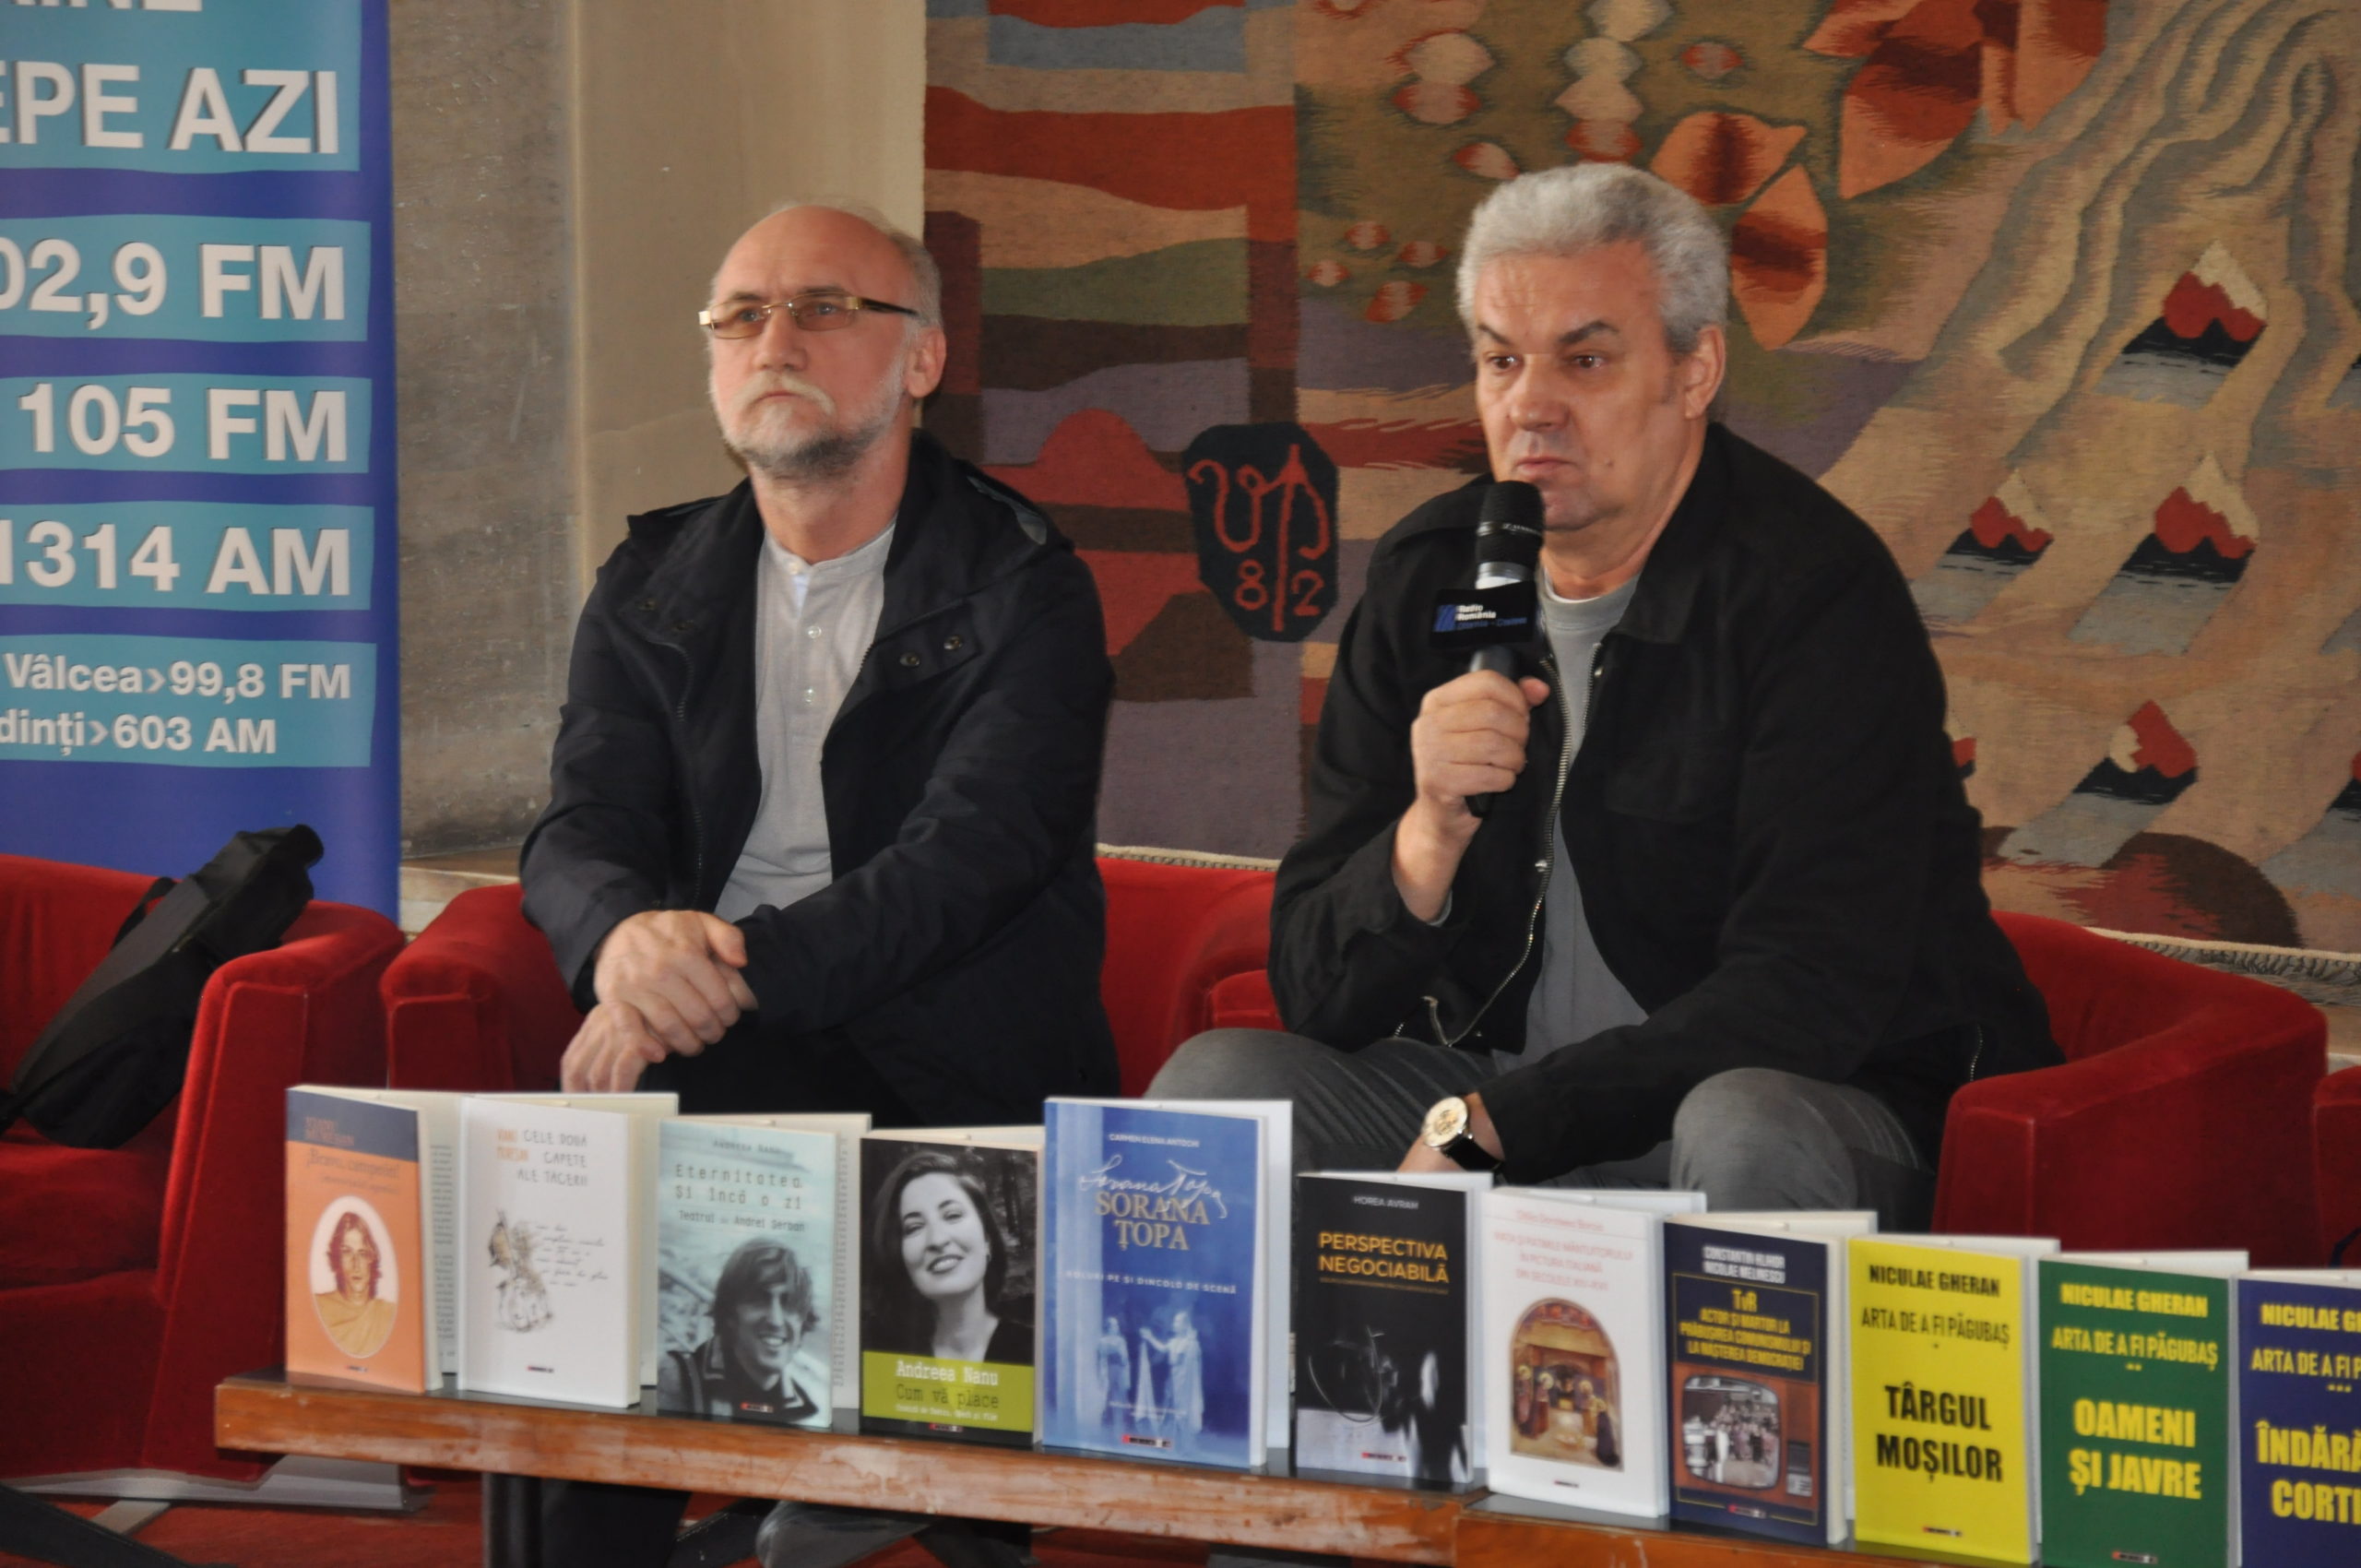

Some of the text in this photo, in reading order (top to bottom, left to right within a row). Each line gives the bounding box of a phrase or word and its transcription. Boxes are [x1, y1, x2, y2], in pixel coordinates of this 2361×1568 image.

[0, 59, 339, 154] PE AZI
[200, 244, 345, 320] FM
[18, 383, 347, 461] 105 FM
[0, 519, 350, 596] 1314 AM
[280, 663, 350, 699] FM
[204, 718, 277, 754] AM
[523, 1129, 553, 1146] CELE
[517, 1168, 539, 1183] ALE
[544, 1150, 587, 1169] CAPETE
[761, 1194, 769, 1207] o
[1095, 1191, 1211, 1226] SORANA
[1353, 1195, 1419, 1210] HOREA AVRAM
[1318, 1231, 1449, 1262] PERSPECTIVA
[1318, 1254, 1450, 1284] NEGOCIABILĂ
[1869, 1265, 2000, 1298] NICULAE GHERAN
[2060, 1282, 2208, 1318] NICULAE GHERAN
[2260, 1302, 2340, 1331] NICULAE
[1861, 1306, 2011, 1350] ARTA DE A FI PĂGUBAȘ
[2051, 1326, 2219, 1372] ARTA DE A FI PĂGUBAȘ
[2250, 1348, 2295, 1374] ARTA
[2296, 1351, 2319, 1376] DE
[2321, 1354, 2333, 1378] A
[2335, 1354, 2351, 1380] FI
[896, 1360, 999, 1386] Andreea Nanu
[896, 1383, 999, 1410] Cum vă place
[1884, 1381, 1991, 1431] TÂRGUL
[2073, 1397, 2196, 1448] OAMENI
[1876, 1433, 2003, 1483] MOȘILOR
[2069, 1448, 2202, 1500] ȘI JAVRE
